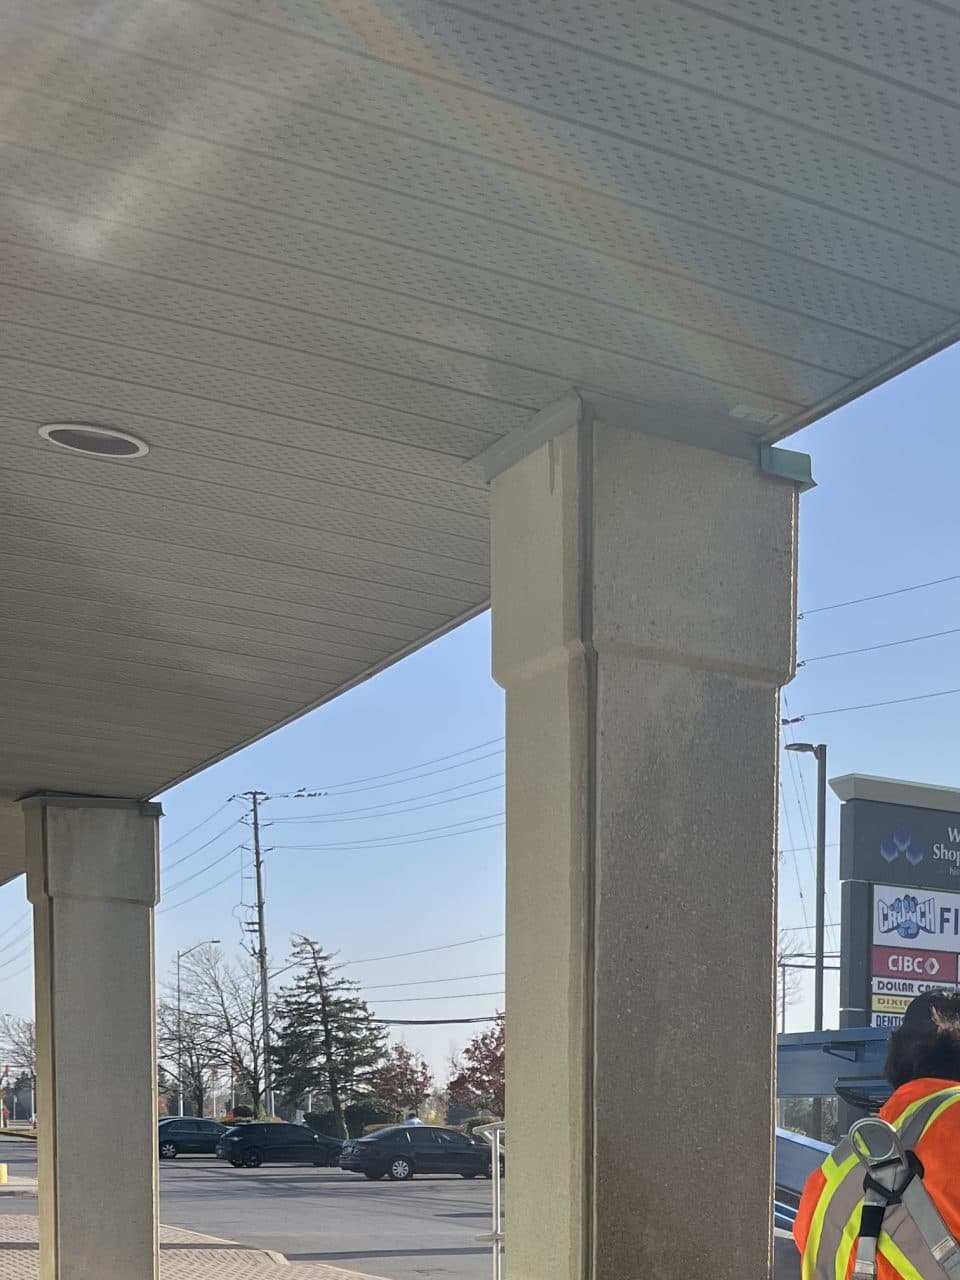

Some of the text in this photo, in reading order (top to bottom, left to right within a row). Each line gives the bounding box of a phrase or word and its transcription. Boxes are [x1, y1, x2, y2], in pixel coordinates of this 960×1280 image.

[878, 897, 936, 934] CRUNCH
[888, 954, 923, 973] CIBC
[877, 980, 914, 993] DOLLAR
